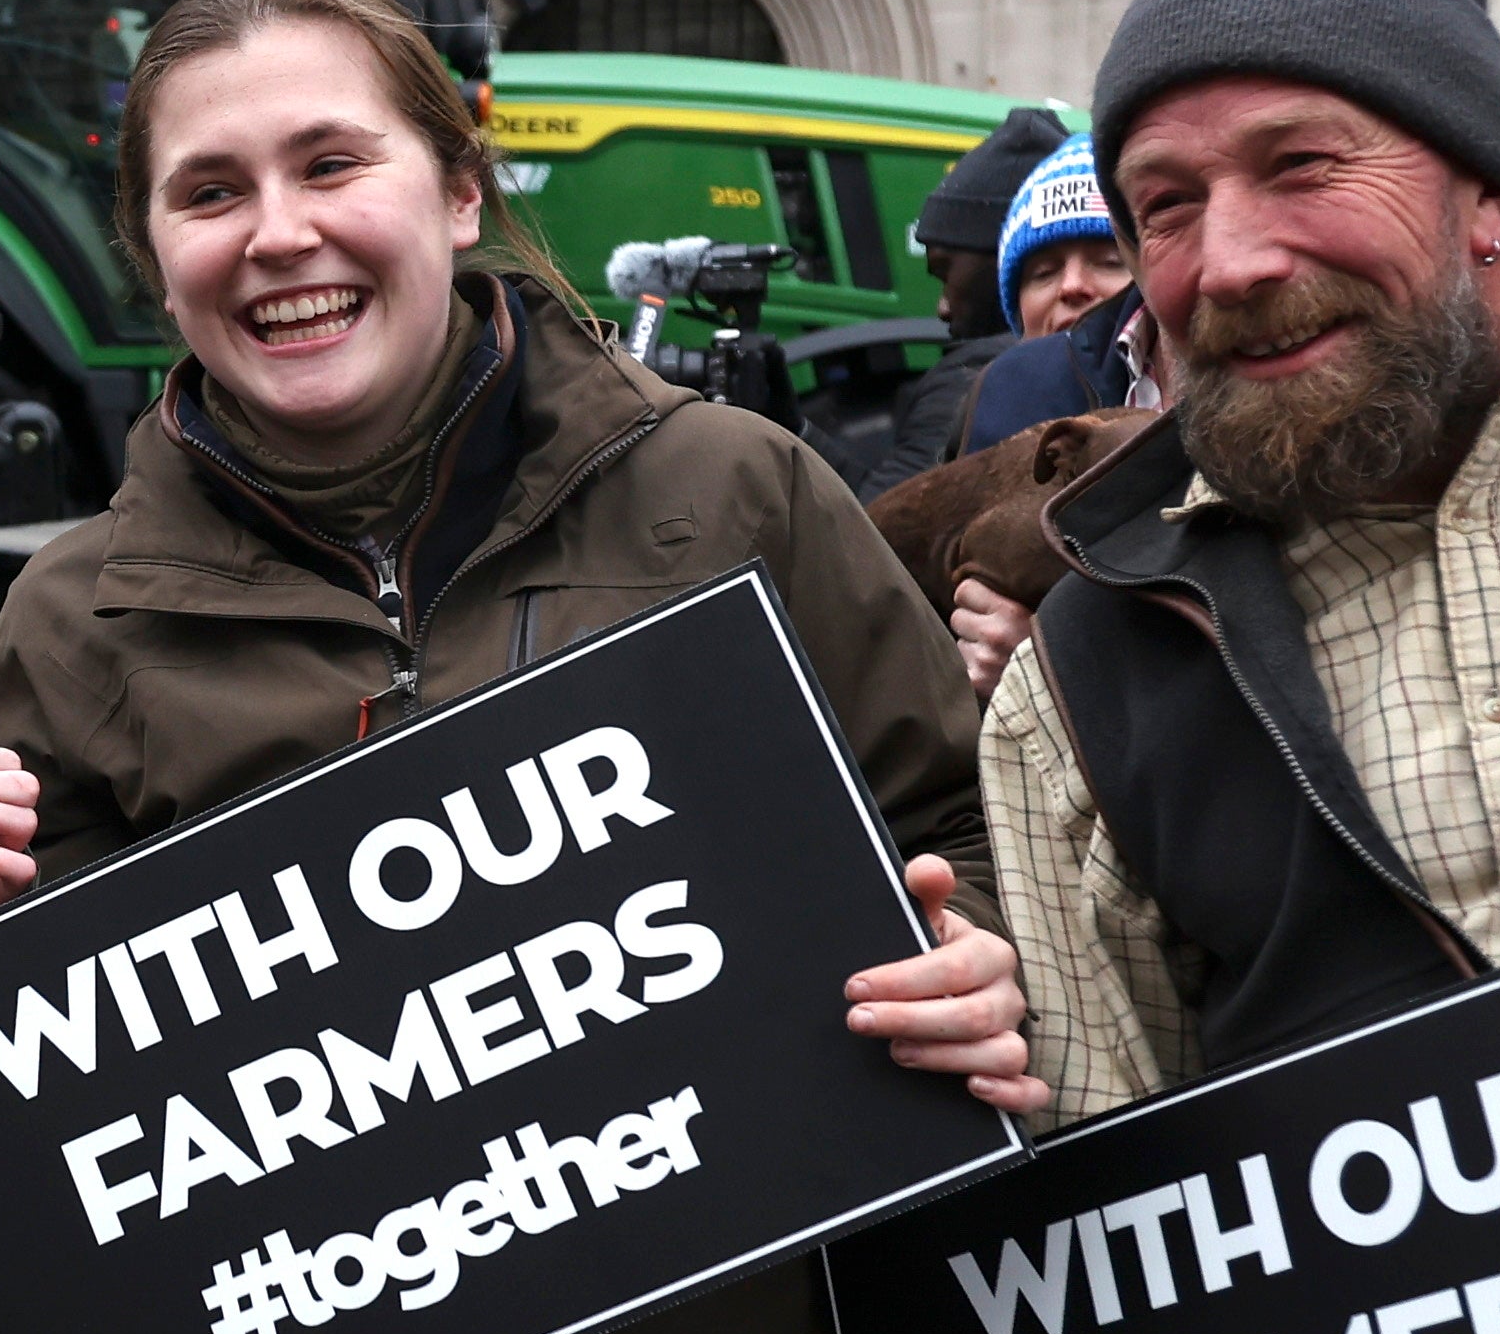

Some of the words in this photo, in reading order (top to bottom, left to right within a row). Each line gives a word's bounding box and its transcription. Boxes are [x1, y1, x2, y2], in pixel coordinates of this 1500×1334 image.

[709, 185, 761, 209] 250
[1041, 196, 1091, 219] TIME
[348, 726, 677, 931] OUR
[60, 879, 724, 1246] FARMERS
